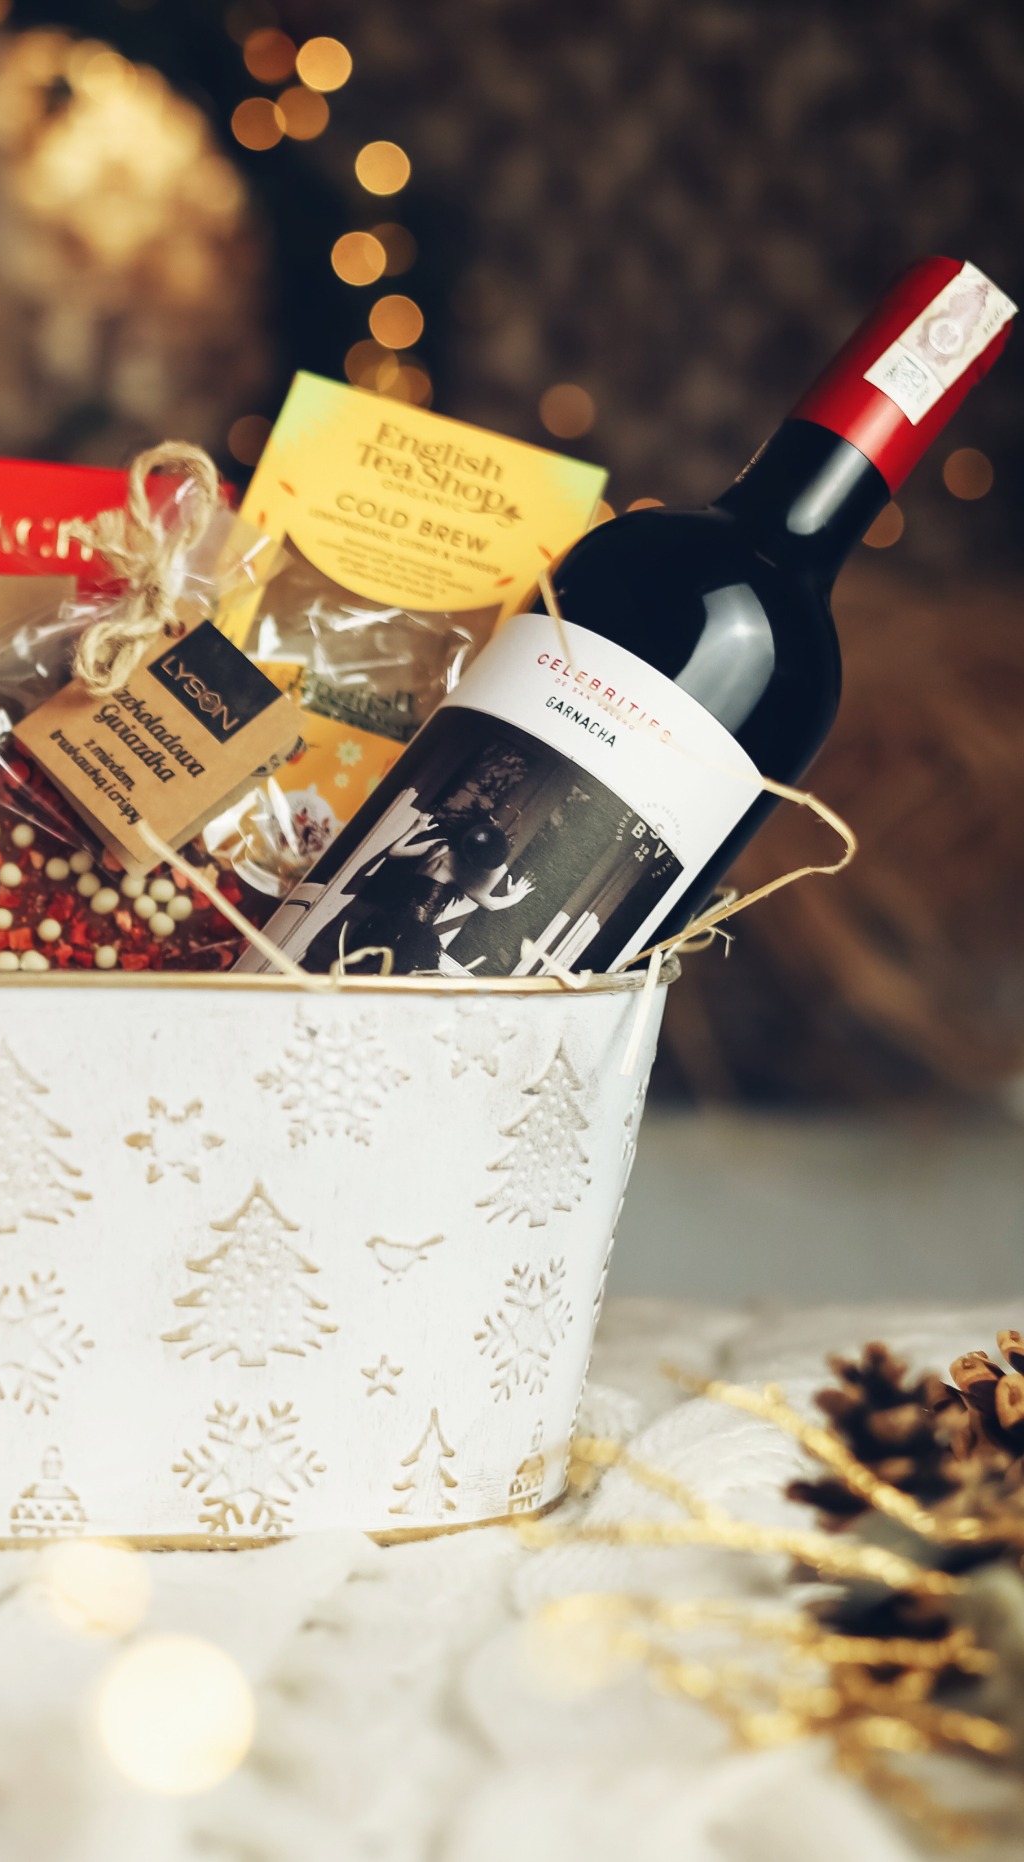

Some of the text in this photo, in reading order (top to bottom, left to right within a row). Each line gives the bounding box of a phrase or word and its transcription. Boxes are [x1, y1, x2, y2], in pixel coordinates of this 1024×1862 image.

[376, 421, 503, 482] English
[335, 492, 491, 552] COLD BREW
[537, 653, 672, 744] CELEBRITIES
[545, 695, 617, 748] GARNACHA
[554, 677, 636, 731] DE SAN VALERO
[93, 703, 176, 784] Gwiazdka
[112, 684, 205, 778] zekoladowa
